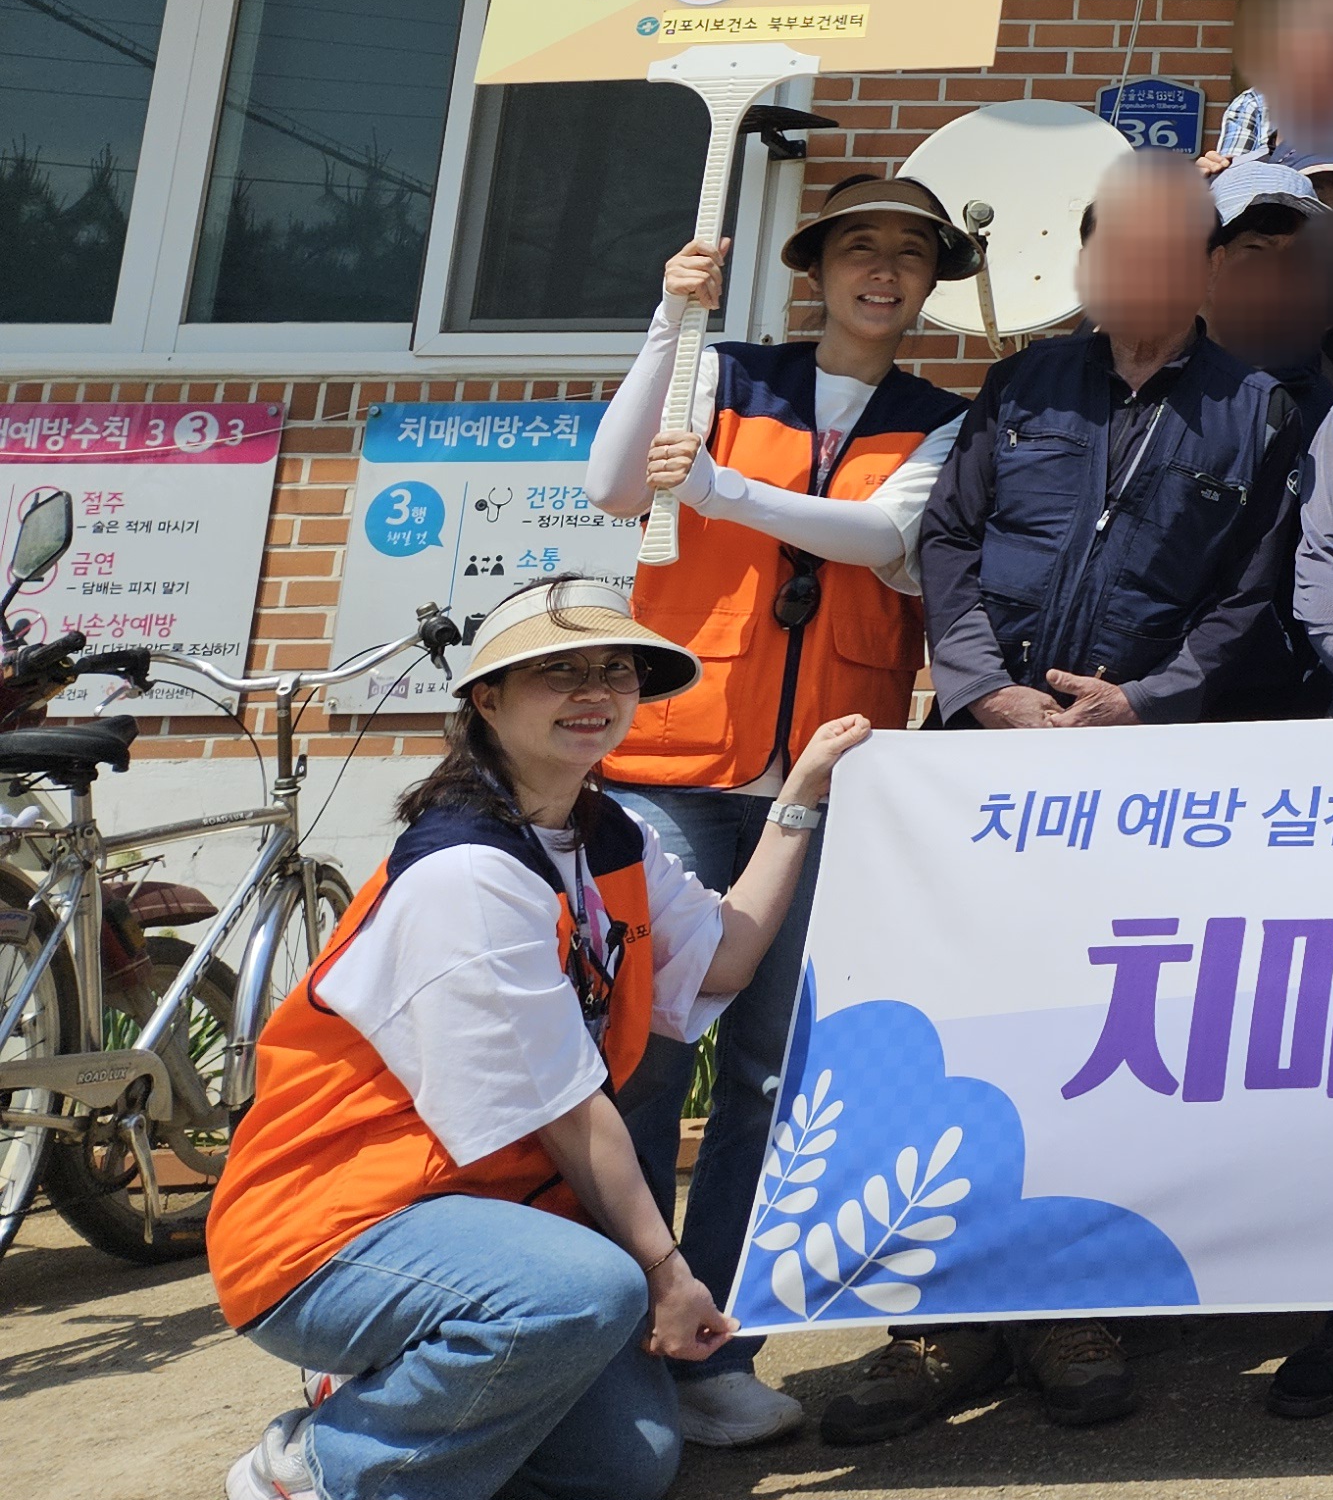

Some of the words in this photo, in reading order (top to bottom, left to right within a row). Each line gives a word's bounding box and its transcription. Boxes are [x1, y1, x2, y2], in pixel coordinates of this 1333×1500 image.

[662, 16, 757, 35] 김포시보건소
[767, 12, 864, 33] 북부보건센터
[1118, 118, 1178, 147] 36
[145, 419, 164, 446] 3
[185, 414, 208, 446] 3
[224, 419, 244, 446] 3
[398, 414, 580, 448] 치매예방수칙
[81, 491, 124, 515] 절주
[92, 520, 119, 533] 술은
[125, 520, 152, 533] 적게
[158, 519, 199, 533] 마시기
[538, 514, 604, 528] 정기적으로
[611, 518, 642, 528] 건강
[71, 552, 115, 576] 금연
[517, 547, 560, 572] 소통
[81, 581, 122, 595] 담배는
[128, 581, 156, 595] 피지
[162, 581, 189, 594] 말기
[60, 613, 176, 638] 뇌손상예방
[188, 642, 240, 656] 조심하기
[415, 682, 449, 694] 김포시
[970, 789, 1101, 852] 치매
[1116, 788, 1245, 849] 예방
[77, 1069, 107, 1084] ROAD
